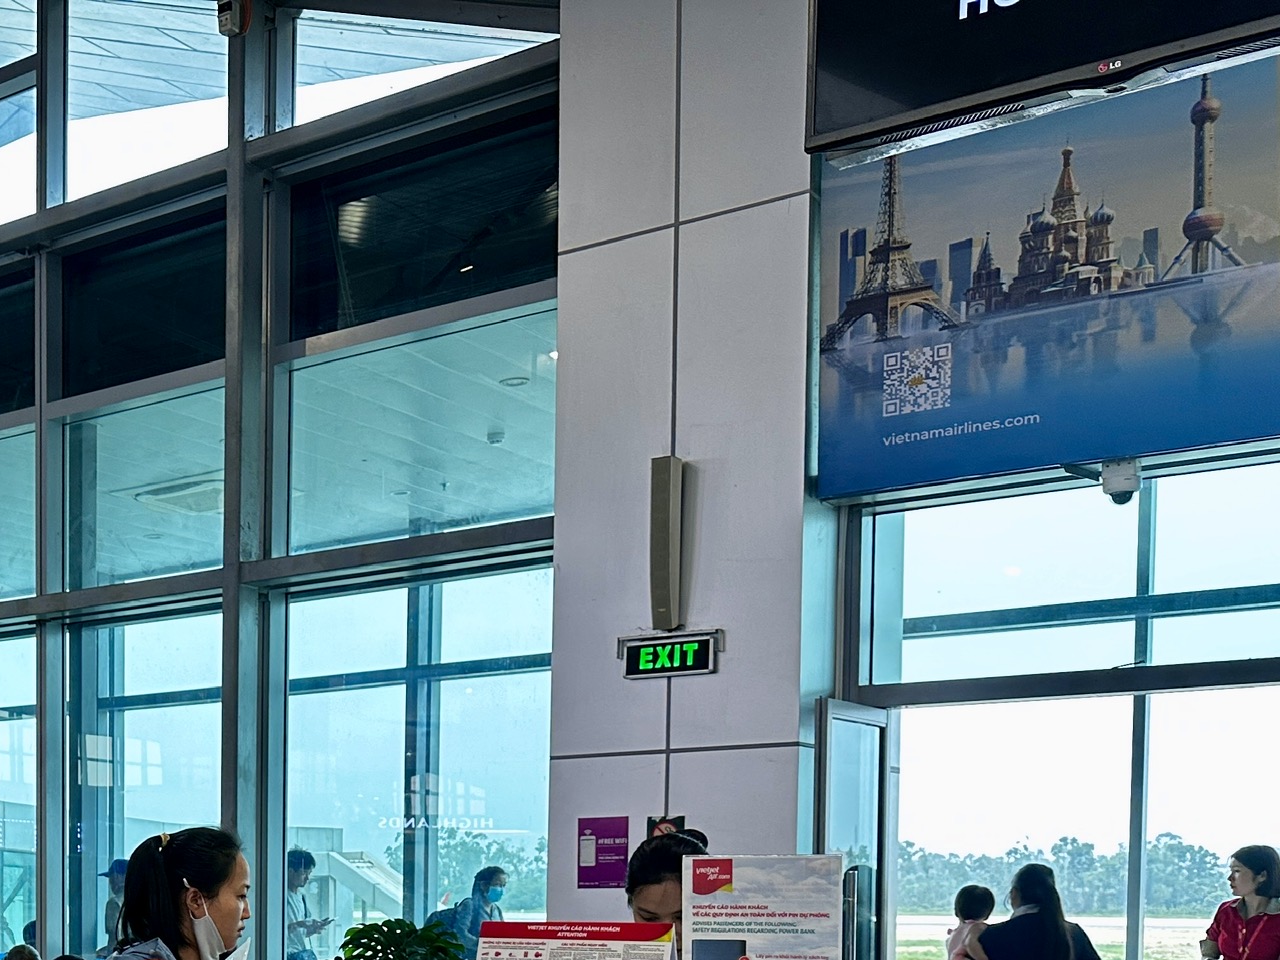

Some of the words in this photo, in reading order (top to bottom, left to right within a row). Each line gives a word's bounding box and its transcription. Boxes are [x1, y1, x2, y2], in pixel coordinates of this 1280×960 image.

[1110, 61, 1121, 69] LG
[882, 414, 1040, 446] vietnamairlines.com
[639, 642, 698, 670] EXIT
